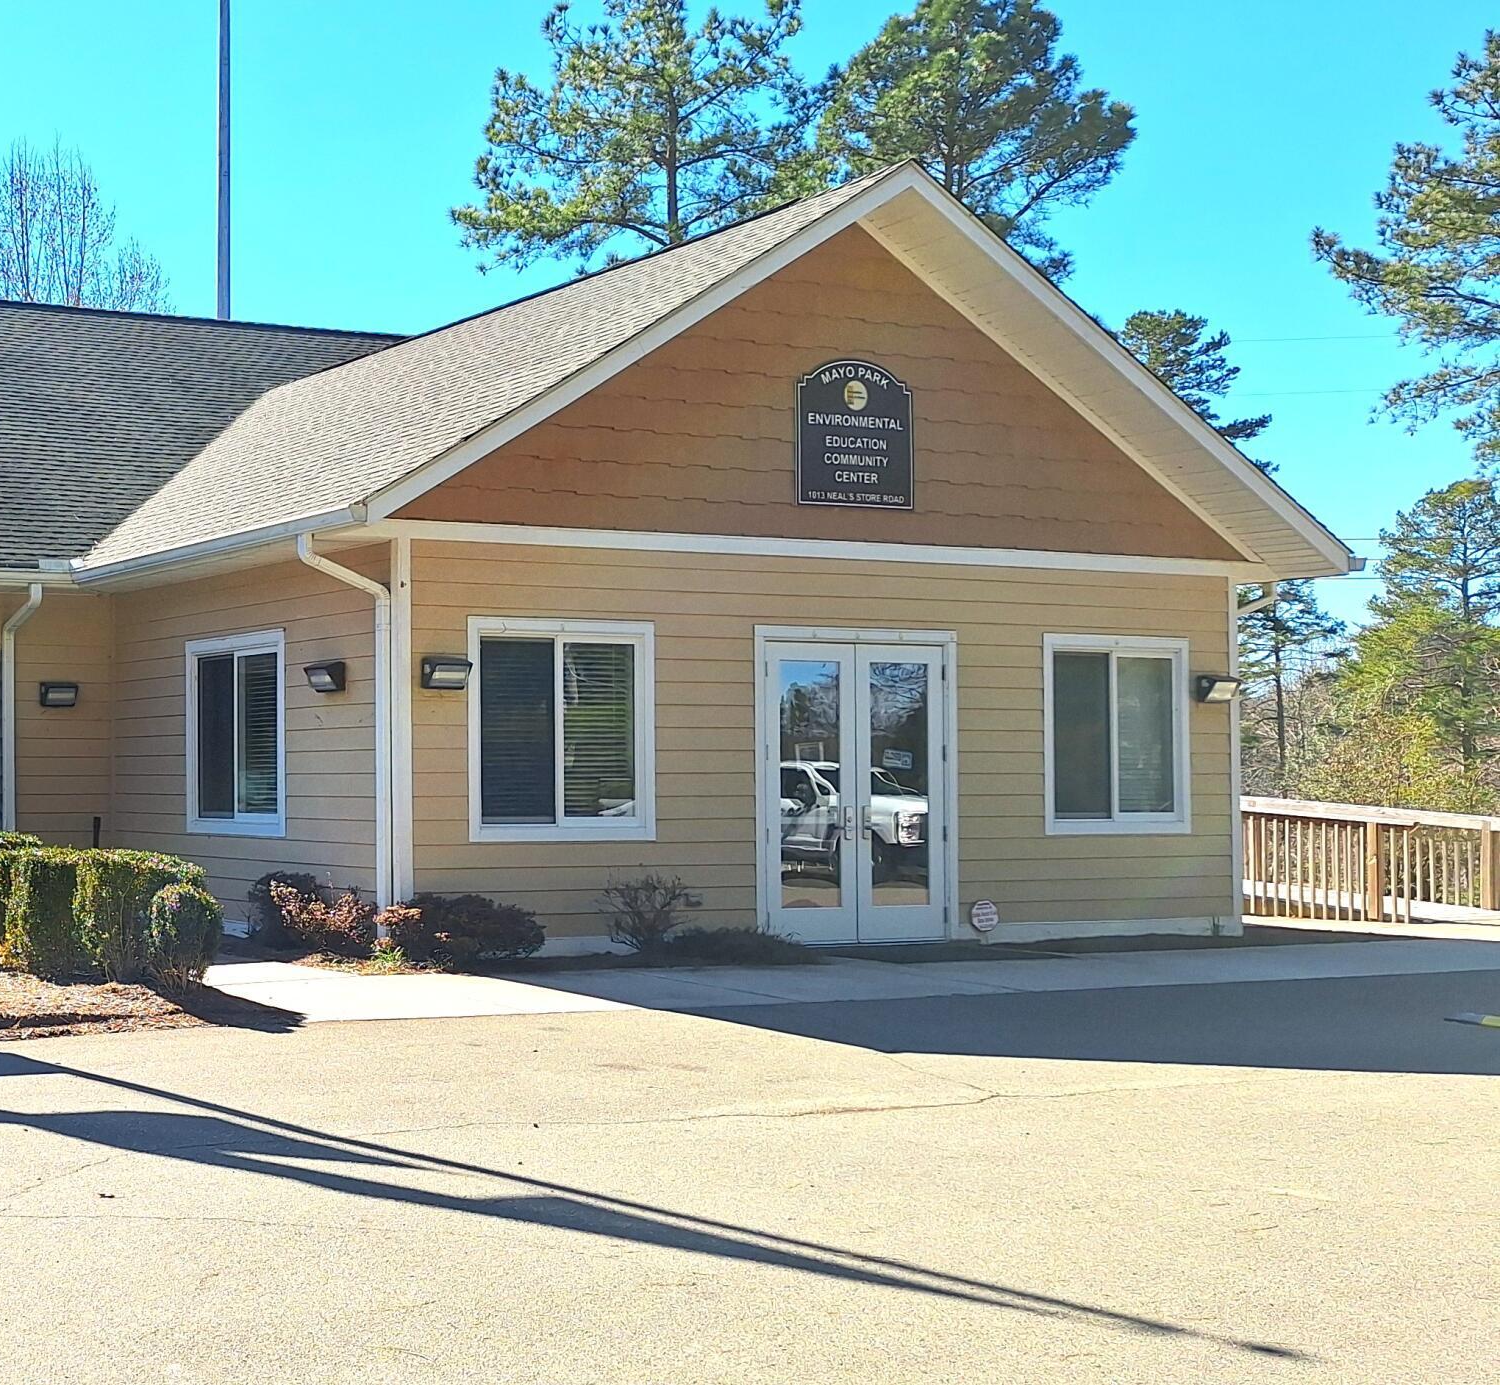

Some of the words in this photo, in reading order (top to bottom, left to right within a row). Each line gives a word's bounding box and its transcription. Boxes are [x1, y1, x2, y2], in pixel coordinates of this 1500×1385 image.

[820, 366, 855, 385] MAYO
[858, 367, 890, 390] PARK
[807, 412, 904, 431] ENVIRONMENTAL
[825, 435, 887, 450] EDUCATION
[824, 453, 889, 468] COMMUNITY
[835, 471, 879, 484] CENTER
[808, 490, 825, 500] 1013
[856, 493, 881, 503] STORE
[883, 494, 905, 504] ROAD
